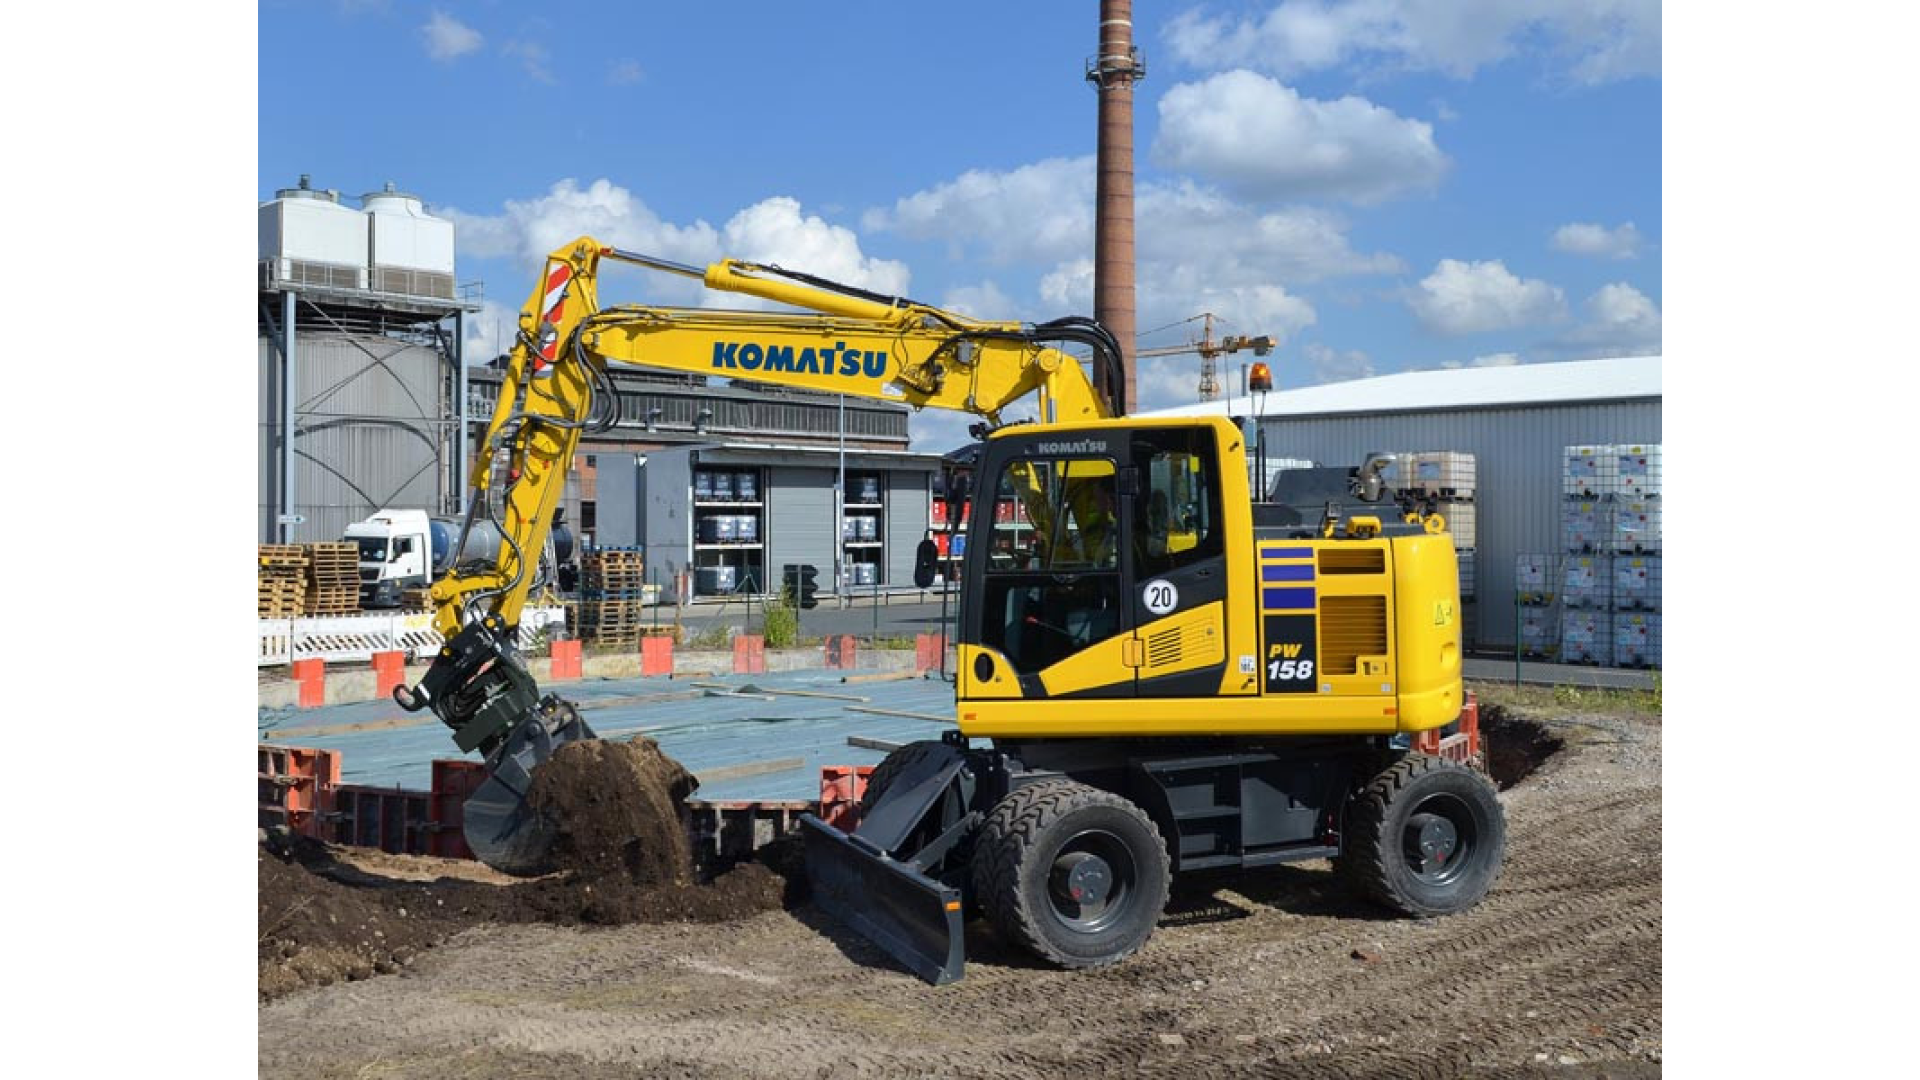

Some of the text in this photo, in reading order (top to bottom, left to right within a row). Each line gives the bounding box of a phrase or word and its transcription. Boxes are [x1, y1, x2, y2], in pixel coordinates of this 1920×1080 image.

[712, 341, 887, 378] KOMATSU
[1038, 438, 1107, 454] KOMATSU
[1150, 586, 1171, 607] 20
[1269, 643, 1303, 658] PW
[1268, 660, 1314, 680] 158
